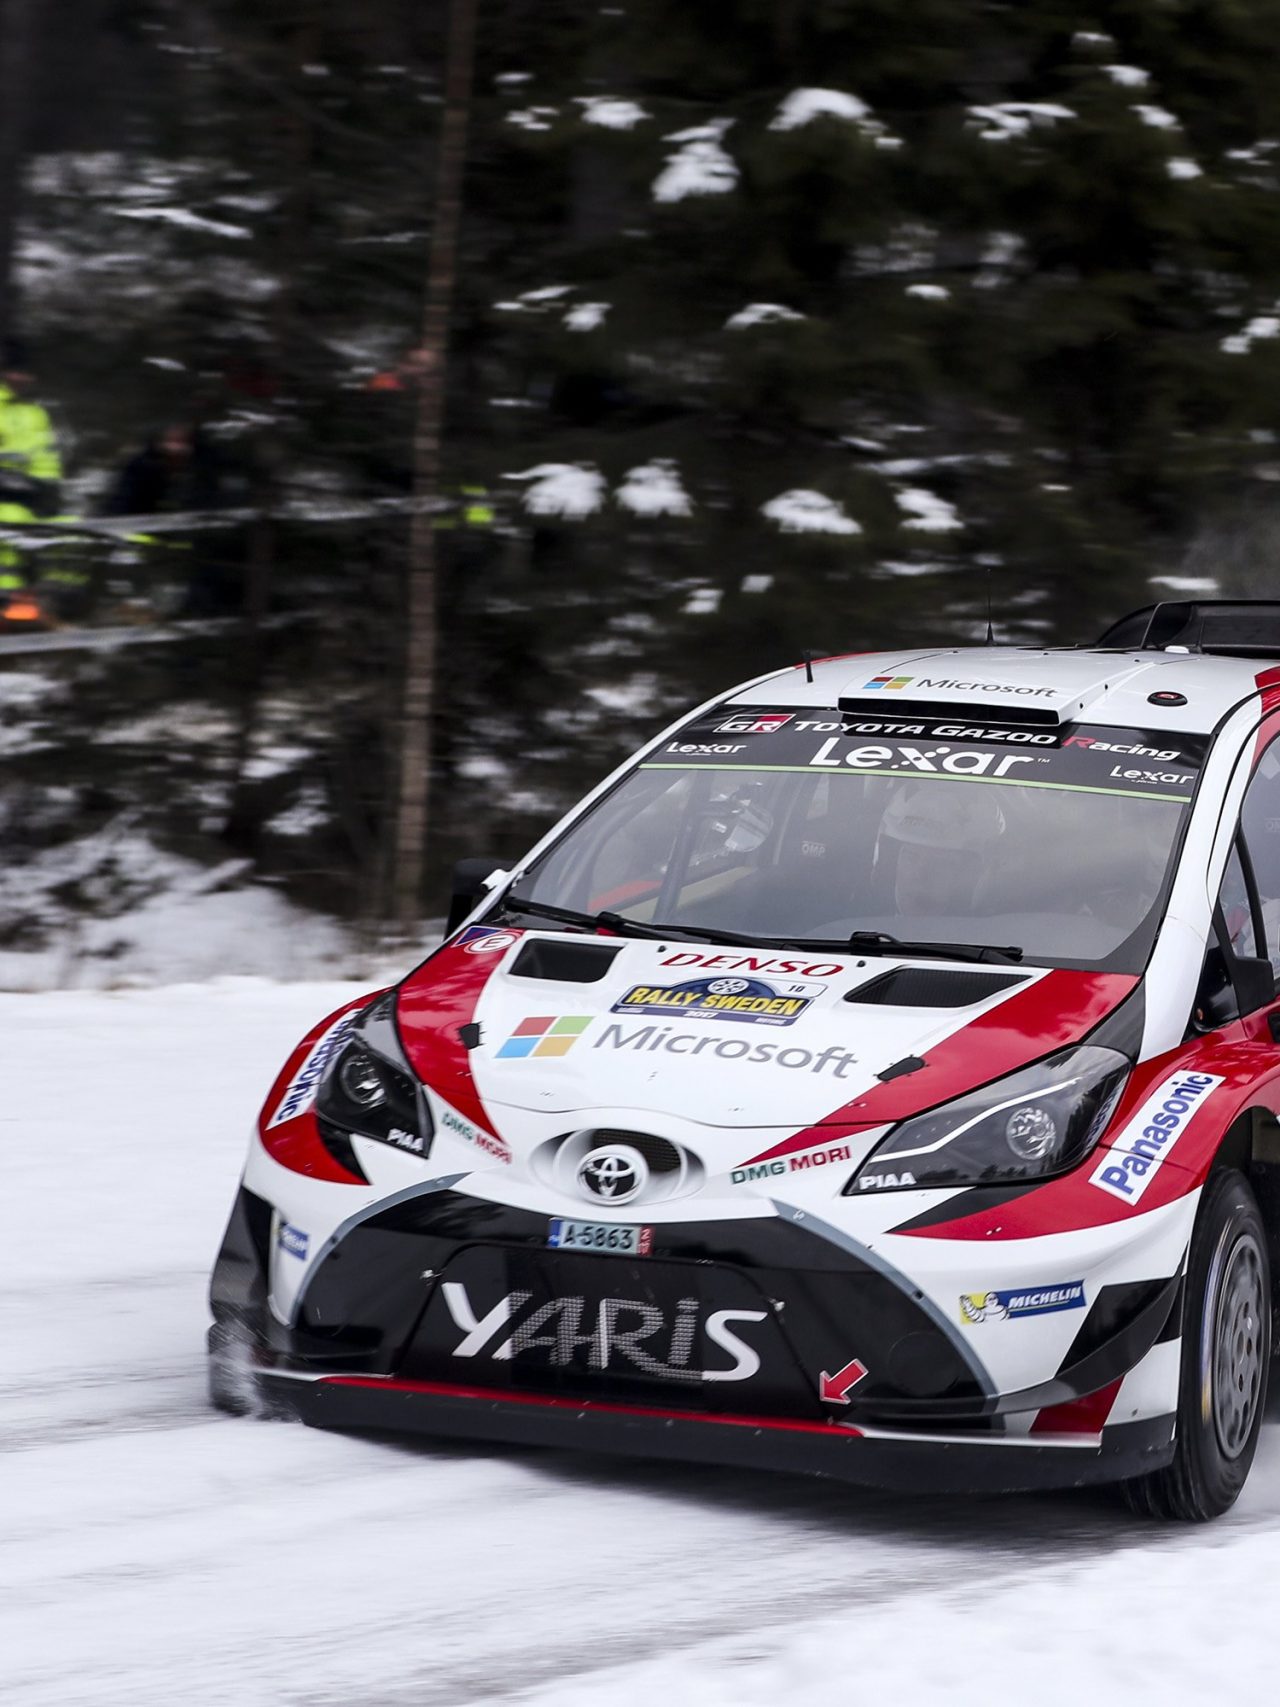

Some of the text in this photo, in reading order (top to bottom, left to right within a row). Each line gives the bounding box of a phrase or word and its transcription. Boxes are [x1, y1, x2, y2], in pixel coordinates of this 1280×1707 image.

[917, 678, 1059, 697] Microsoft
[666, 741, 748, 754] Lexar
[717, 718, 1181, 761] GR TOYOTA GAZOO Racing
[809, 737, 1034, 777] Lexar
[1109, 764, 1195, 785] Lexar
[659, 952, 845, 978] DENSO
[624, 986, 806, 1016] RALLY SWEDEN
[789, 983, 806, 993] 10
[592, 1024, 859, 1080] Microsoft
[1099, 1070, 1214, 1196] Panasonic
[730, 1145, 852, 1185] DMG MORI
[858, 1171, 917, 1191] PIAA
[563, 1223, 635, 1250] A-5863
[1008, 1284, 1083, 1309] MICHELIN
[441, 1281, 769, 1382] YARIS
